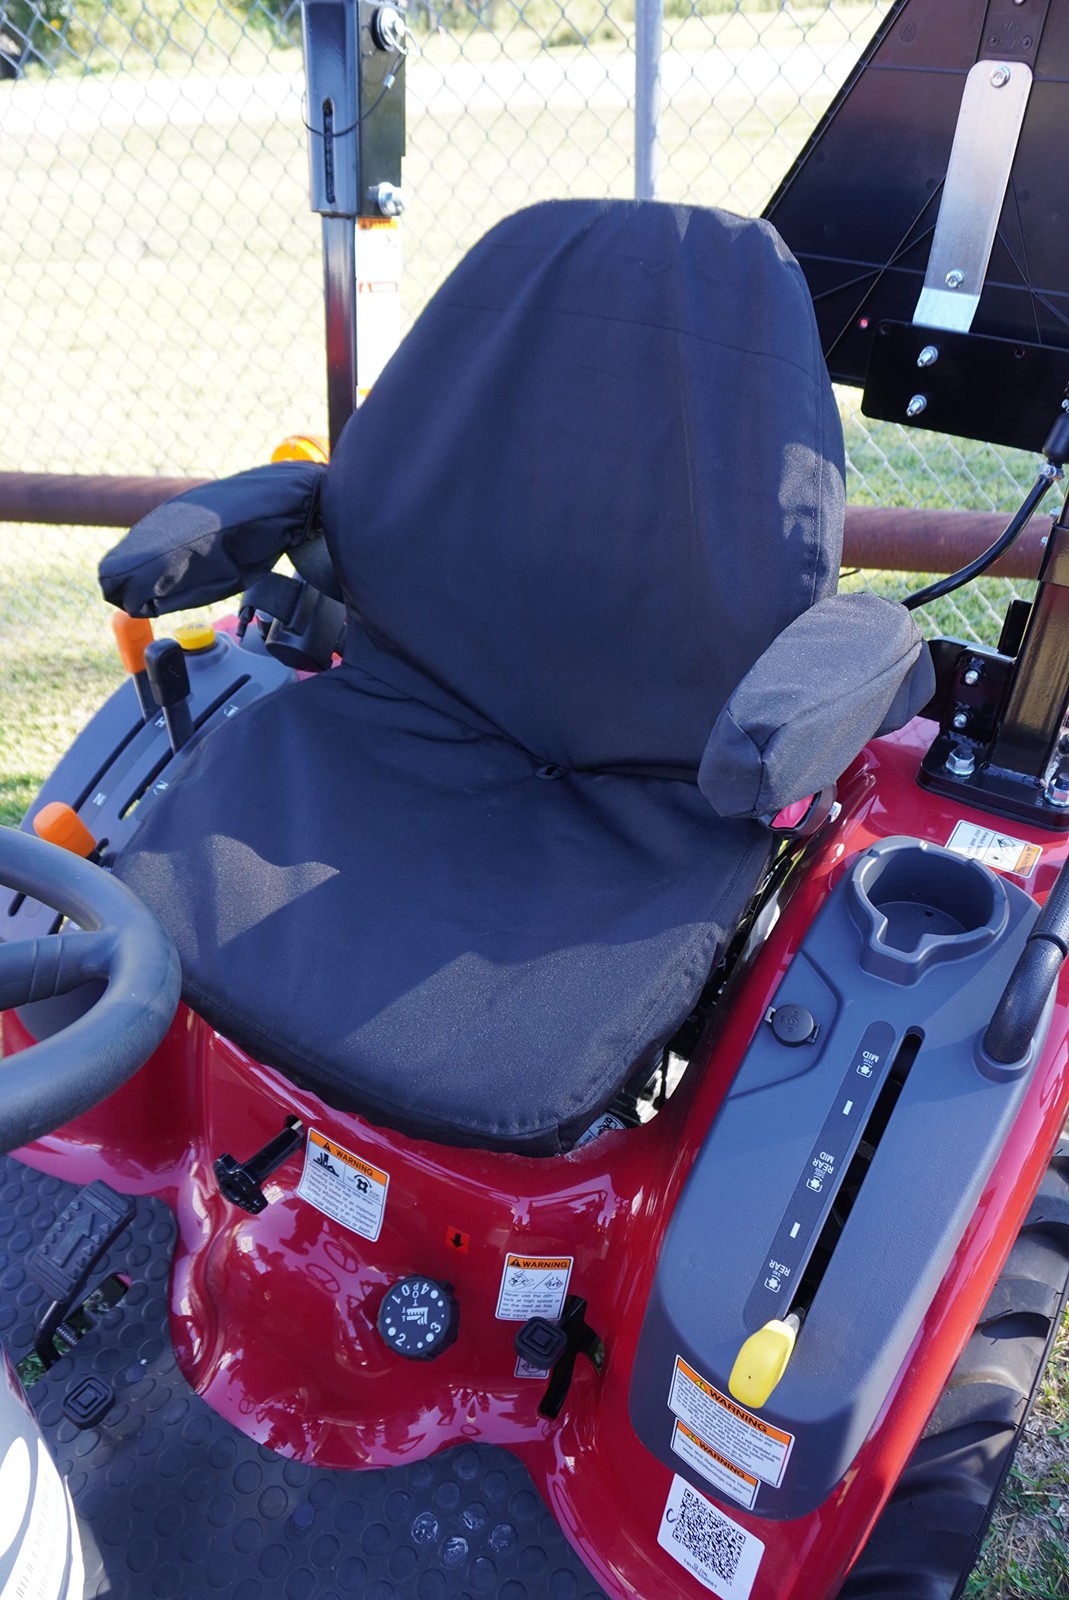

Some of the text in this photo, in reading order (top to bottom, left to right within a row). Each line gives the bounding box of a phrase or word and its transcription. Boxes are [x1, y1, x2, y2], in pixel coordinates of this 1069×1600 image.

[862, 1050, 880, 1063] MID
[335, 1148, 373, 1177] WARNING
[819, 1151, 835, 1164] MID
[812, 1157, 835, 1175] REAR
[522, 1260, 568, 1269] WARNING
[769, 1259, 791, 1277] REAR
[420, 1282, 430, 1295] 4
[429, 1321, 441, 1333] 3
[394, 1332, 406, 1346] 2
[709, 1389, 767, 1433] WARNING
[699, 1441, 745, 1479] WARNING
